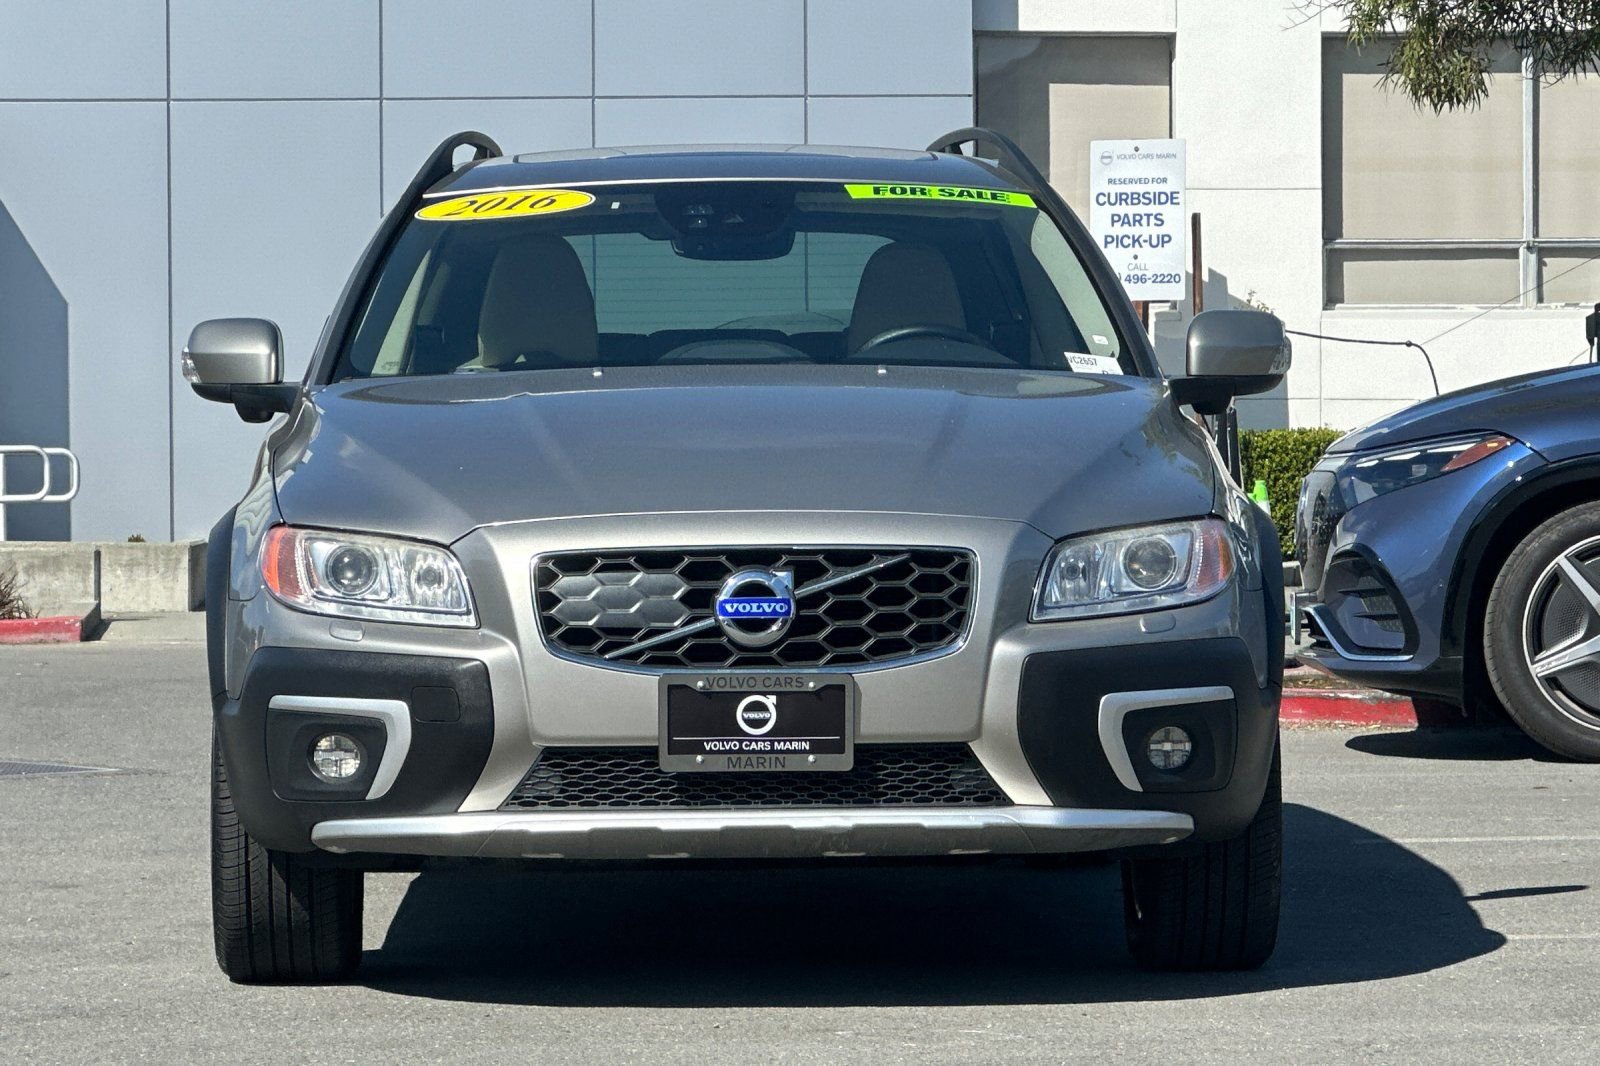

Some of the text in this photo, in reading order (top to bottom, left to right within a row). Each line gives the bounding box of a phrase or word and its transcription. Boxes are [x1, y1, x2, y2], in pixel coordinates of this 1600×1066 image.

[1116, 153, 1137, 161] VOLVO
[1155, 152, 1177, 160] MARIN
[1107, 177, 1168, 185] RESERVED FOR
[872, 185, 1008, 202] FOR SALE
[1095, 191, 1181, 206] CURBSIDE
[440, 193, 558, 217] 2016
[1110, 212, 1165, 227] PARTS
[1103, 233, 1173, 249] PICK-UP
[1127, 262, 1149, 271] CALL
[1124, 273, 1182, 284] 496-2220
[724, 602, 788, 613] VOLVO
[705, 676, 804, 689] VOLVO CARS
[742, 711, 771, 719] VOLVO
[703, 741, 810, 751] VOLVO CARS MARIN
[727, 756, 786, 769] MARIN
